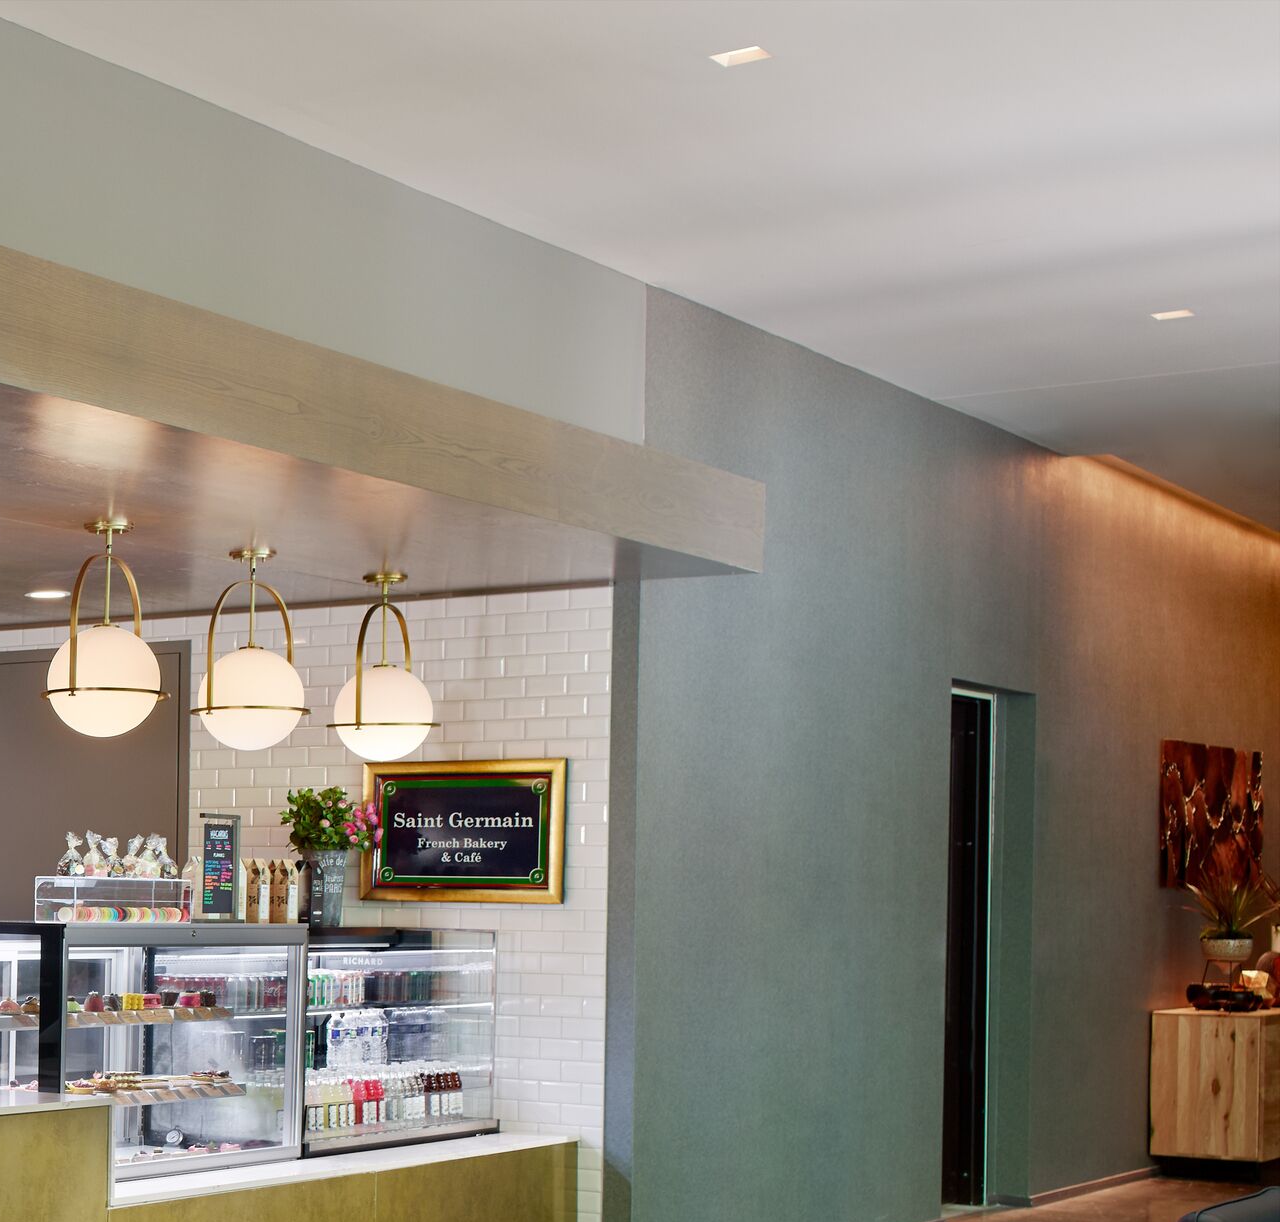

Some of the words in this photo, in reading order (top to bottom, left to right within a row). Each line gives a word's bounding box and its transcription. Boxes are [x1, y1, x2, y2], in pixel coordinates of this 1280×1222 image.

[393, 812, 444, 828] Saint
[449, 811, 534, 828] Germain
[417, 837, 460, 849] French
[463, 837, 507, 850] Bakery
[441, 852, 452, 863] &
[454, 851, 482, 863] Café
[342, 956, 383, 966] RICHARD
